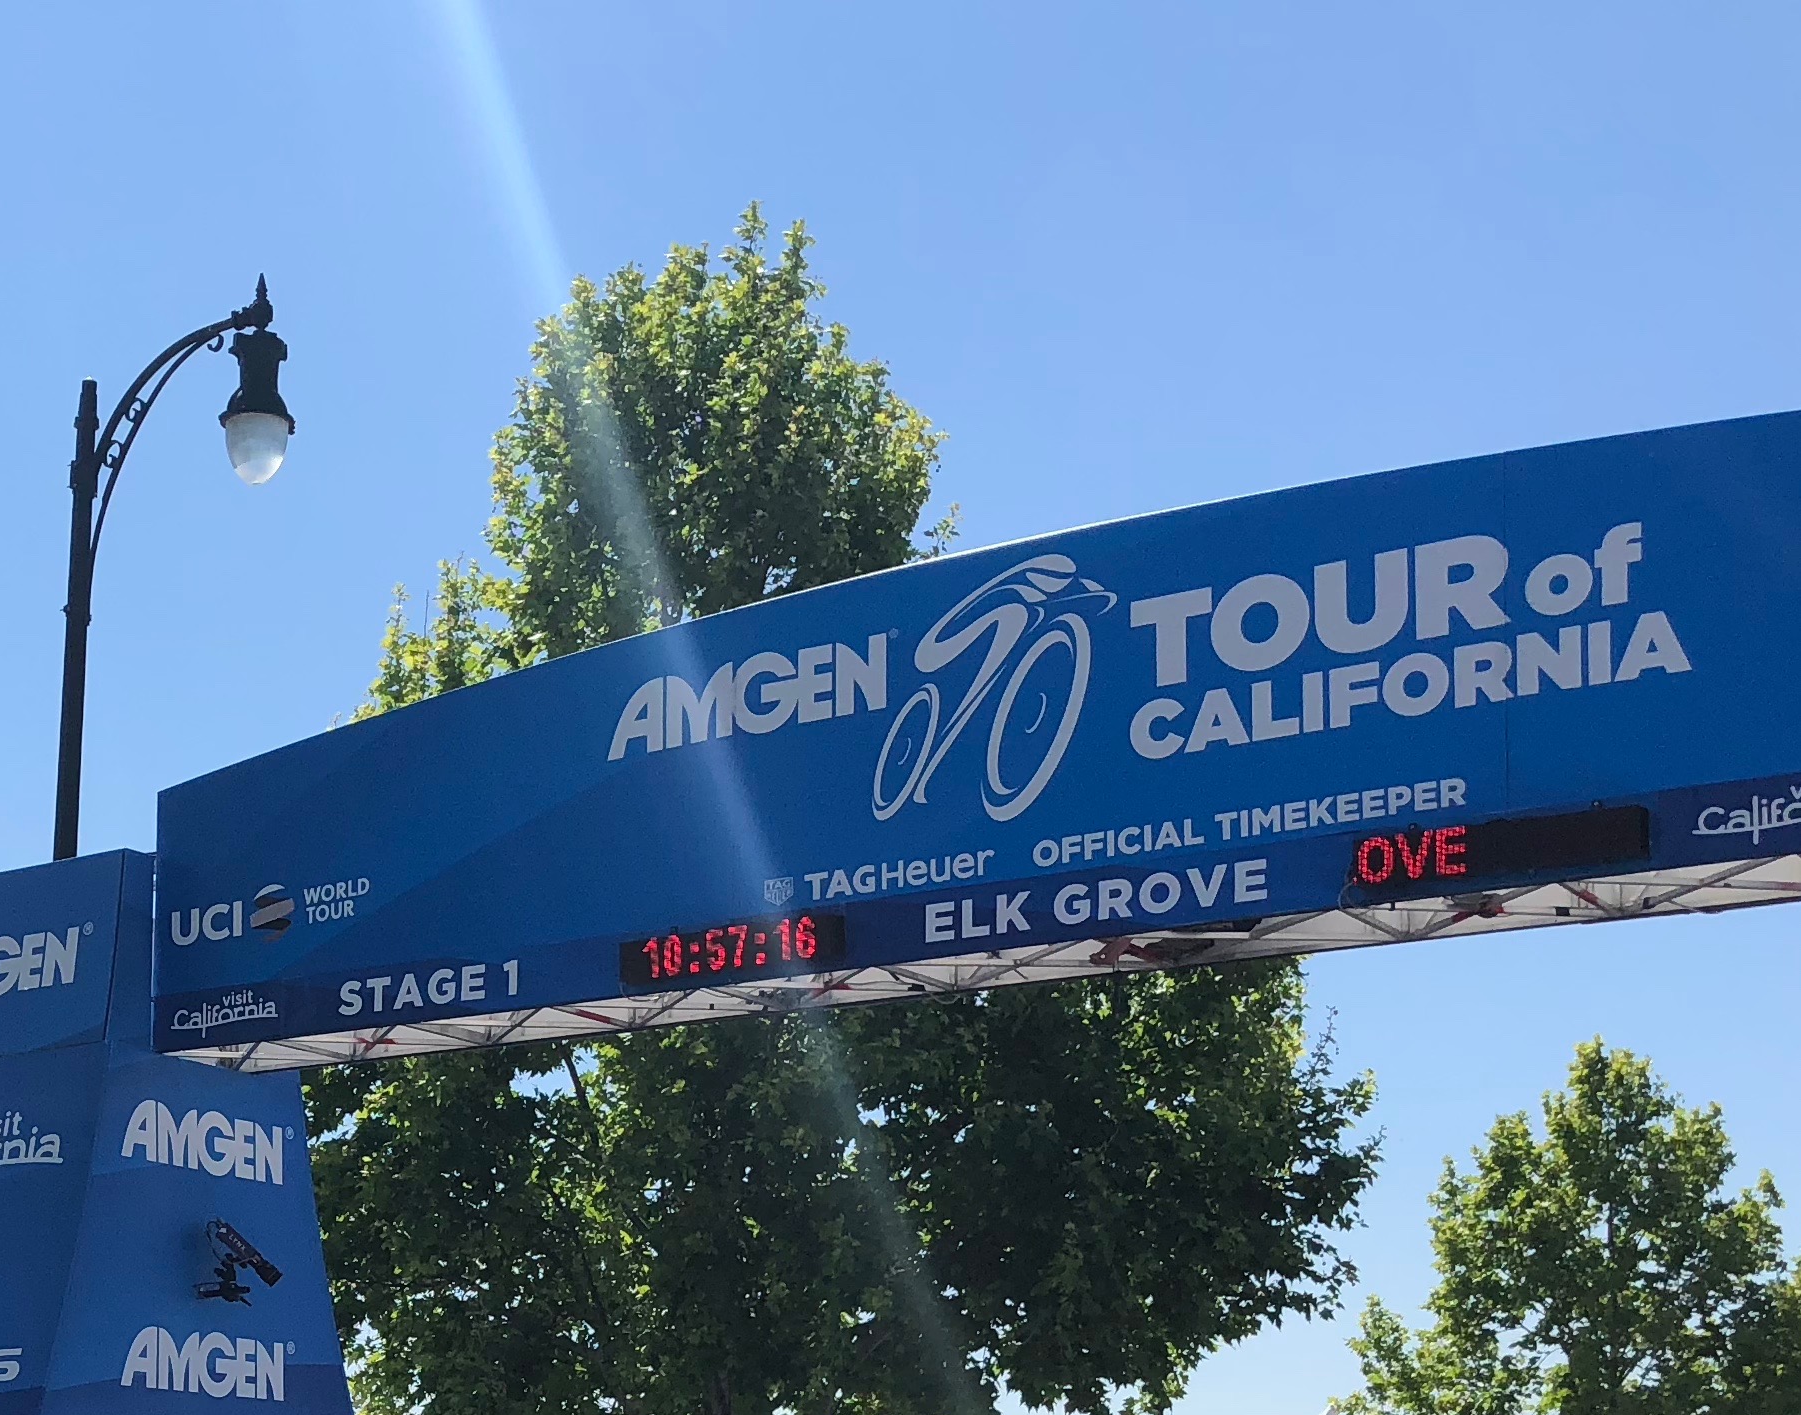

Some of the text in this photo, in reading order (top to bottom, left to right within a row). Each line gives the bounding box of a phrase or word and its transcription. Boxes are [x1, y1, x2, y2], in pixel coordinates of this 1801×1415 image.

[1129, 521, 1643, 687] TOUR of
[607, 640, 887, 762] AMGEN
[1129, 611, 1692, 761] CALIFORNIA
[1033, 777, 1466, 868] OFFICIAL TIMEKEEPER
[1356, 825, 1467, 885] OVE
[171, 901, 243, 947] UCI
[303, 877, 370, 905] WORLD
[305, 898, 354, 924] TOUR
[924, 860, 1268, 944] ELK GROVE
[641, 915, 818, 981] 10:57:16
[171, 997, 278, 1038] California
[222, 989, 254, 1007] visit
[338, 959, 519, 1016] STAGE 1
[122, 1100, 283, 1185] AMGEN
[121, 1325, 284, 1401] AMGEN
